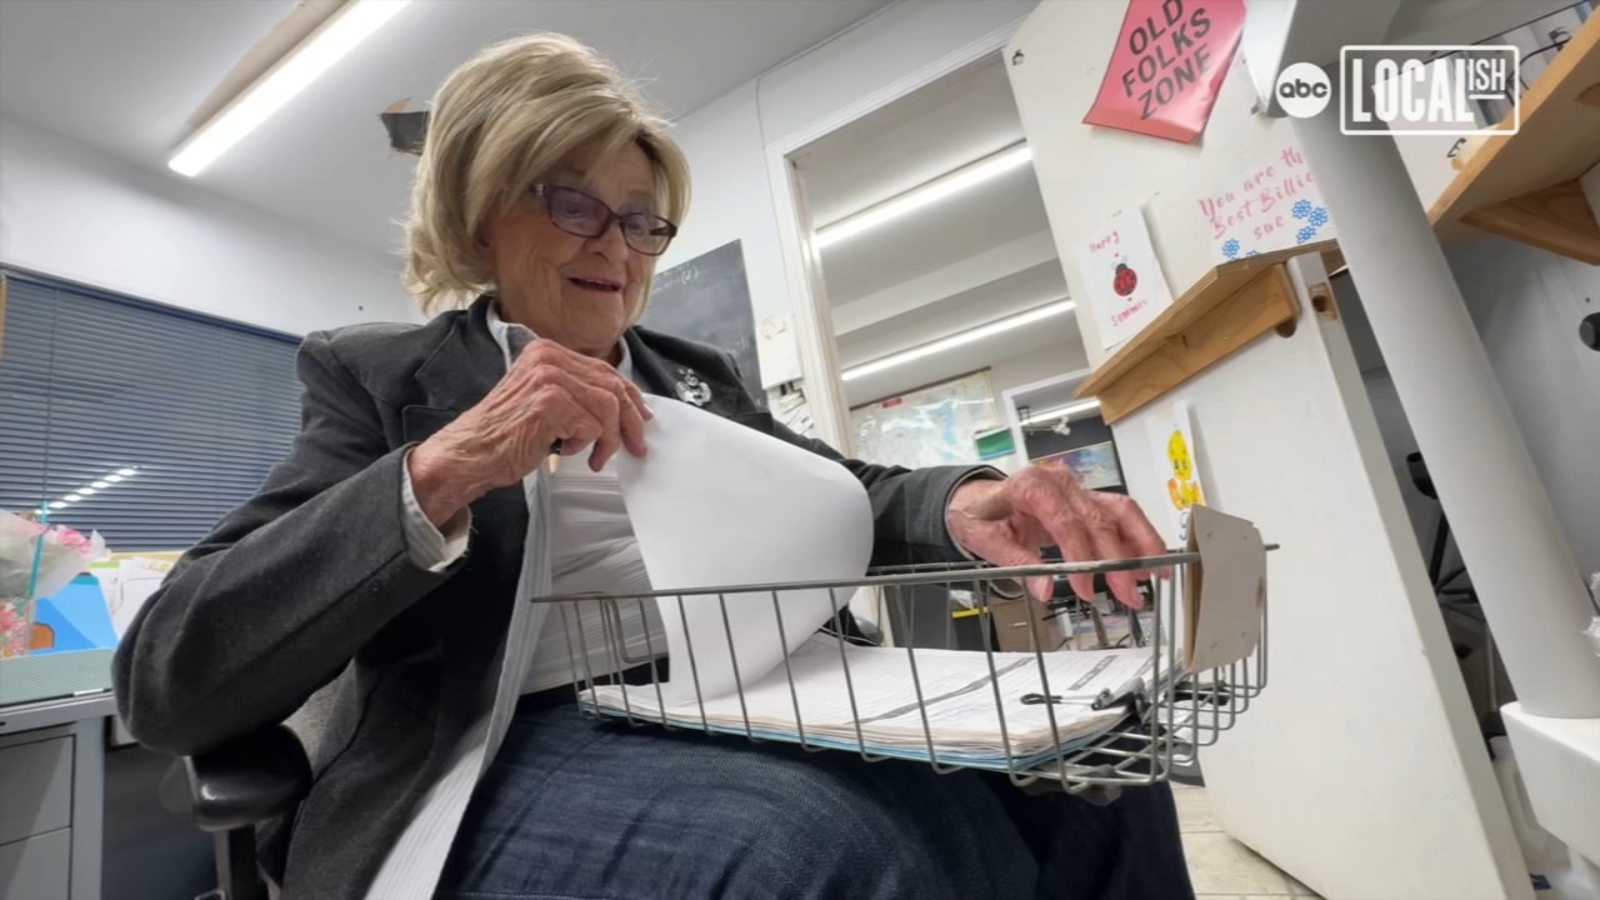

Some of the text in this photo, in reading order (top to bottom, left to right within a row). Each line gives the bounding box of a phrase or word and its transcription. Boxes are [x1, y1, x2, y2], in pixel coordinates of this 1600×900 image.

[1121, 8, 1212, 98] FOLKS
[1129, 0, 1184, 55] OLD
[1137, 42, 1212, 121] ZONE
[1200, 147, 1304, 223] You are th
[1213, 171, 1314, 240] Best Billie
